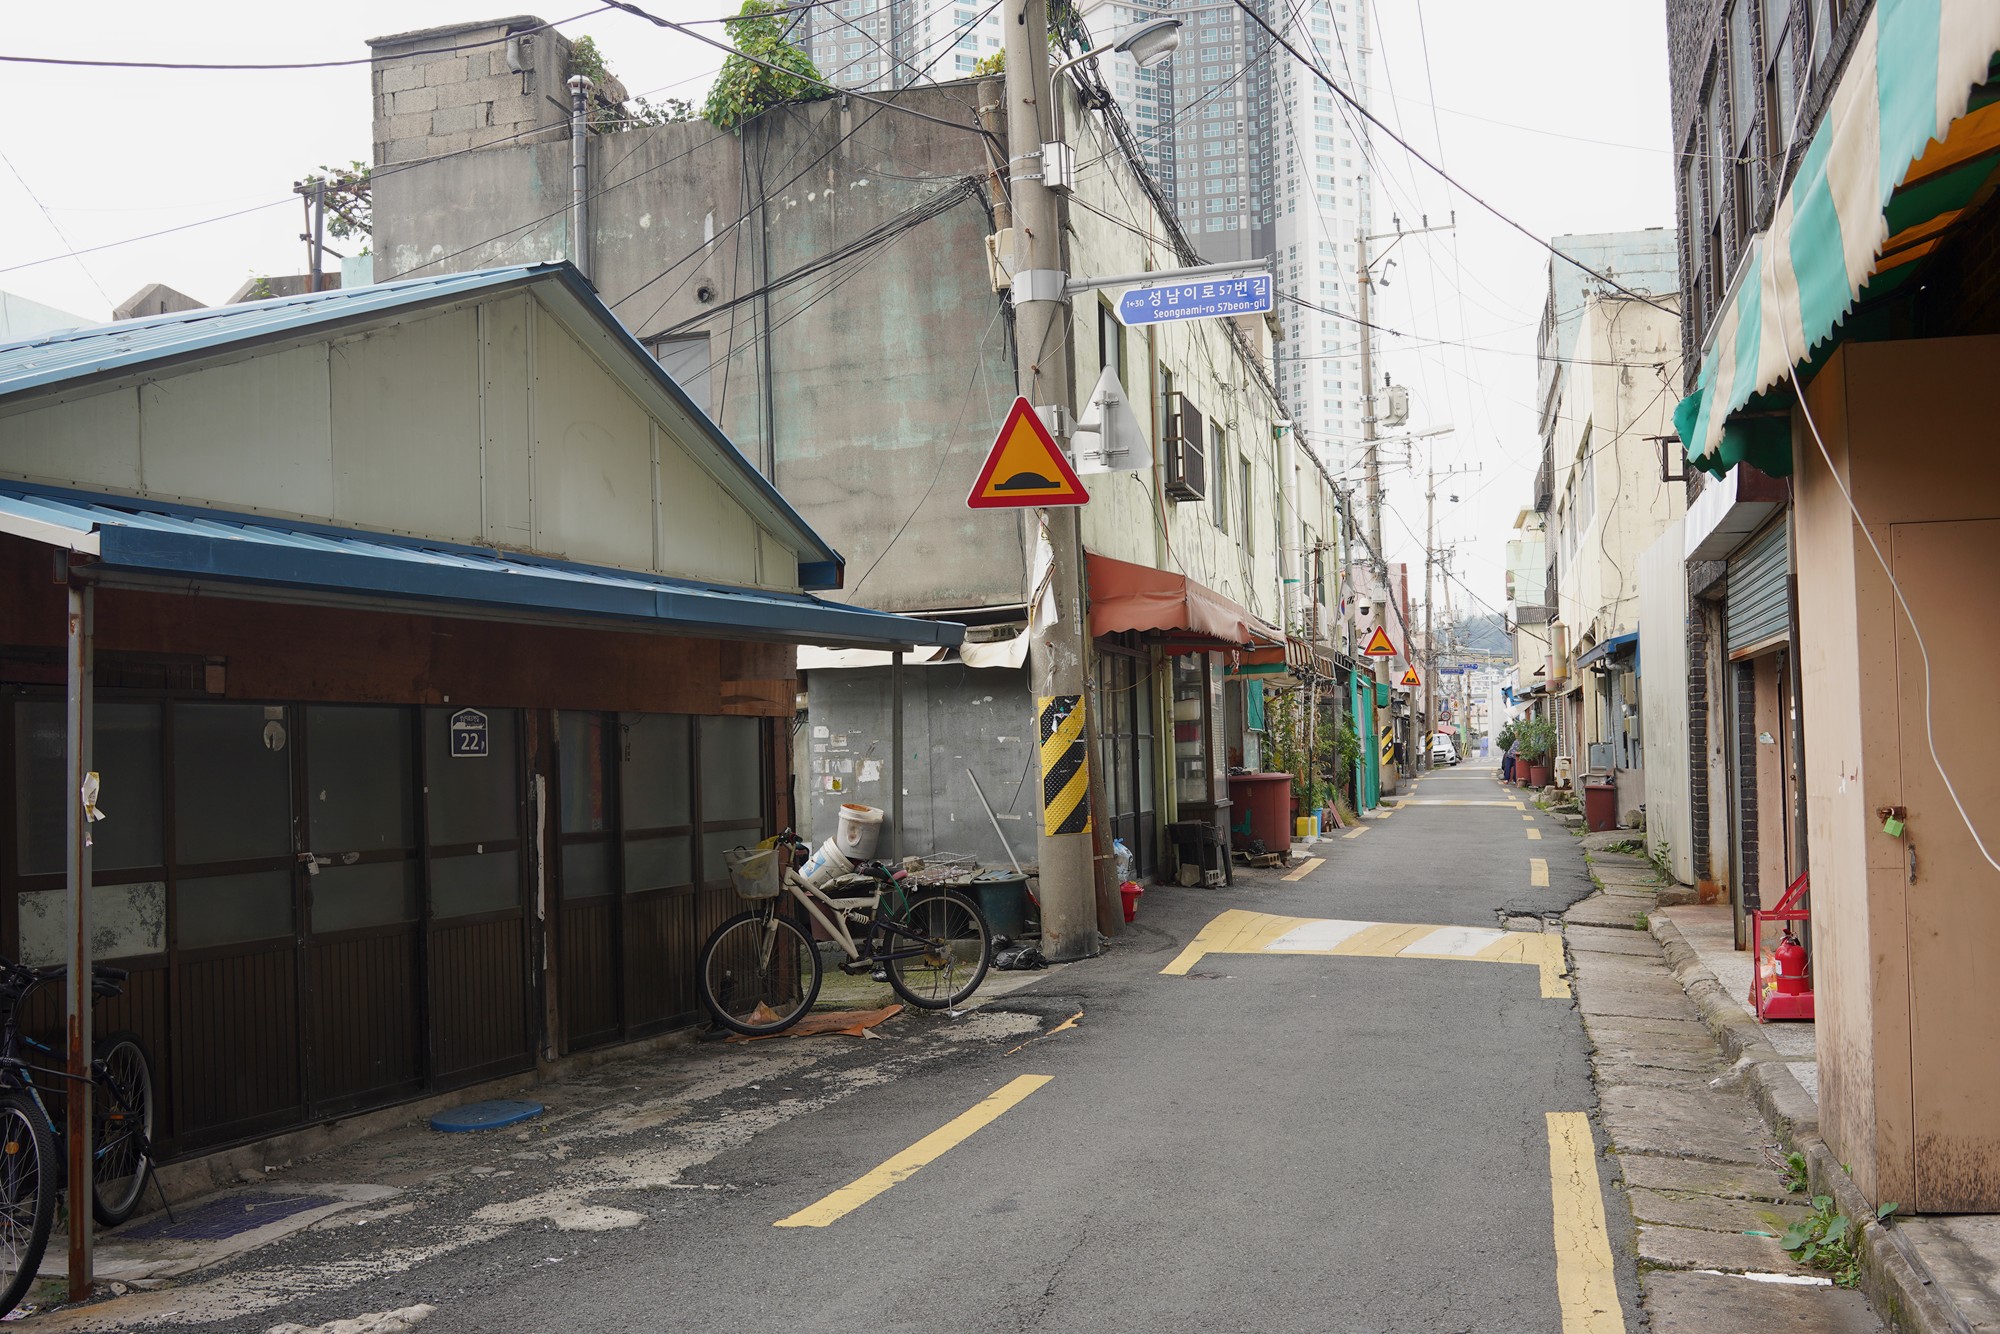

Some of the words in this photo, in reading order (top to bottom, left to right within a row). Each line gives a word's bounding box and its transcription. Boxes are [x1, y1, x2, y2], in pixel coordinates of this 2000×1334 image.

[1154, 306, 1215, 319] Seongnami-ro
[1217, 299, 1266, 312] 57beon-gil
[461, 732, 479, 750] 22
